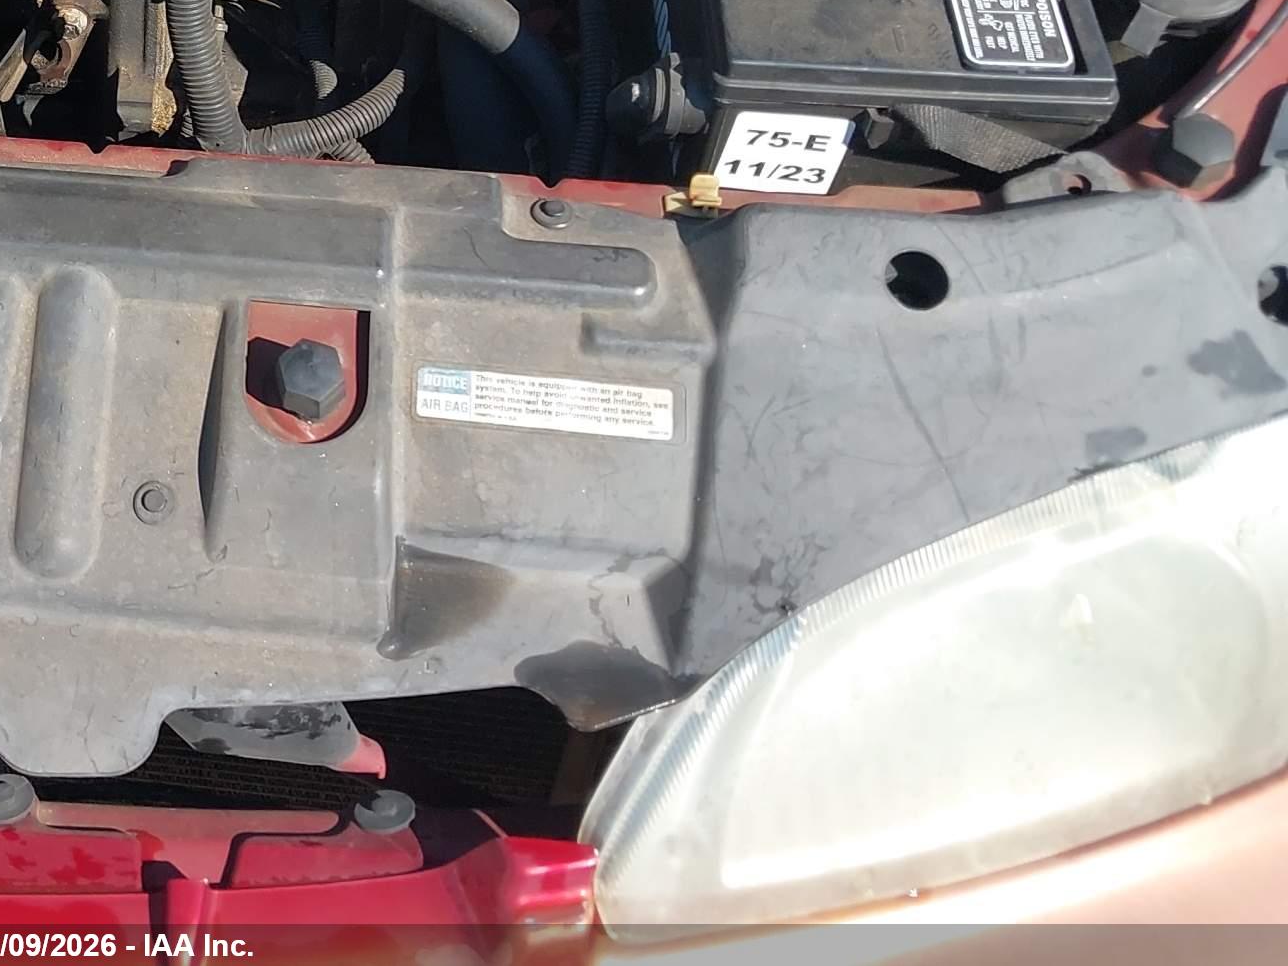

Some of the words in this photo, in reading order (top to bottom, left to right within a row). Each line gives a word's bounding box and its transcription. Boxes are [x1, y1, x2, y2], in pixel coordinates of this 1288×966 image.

[746, 129, 832, 152] 75-E
[724, 159, 827, 184] 11/23
[422, 373, 468, 390] NOTICE
[476, 374, 493, 383] This
[496, 377, 526, 387] vehicle
[528, 379, 536, 387] is
[626, 390, 643, 399] bag
[511, 387, 520, 395] To
[522, 389, 542, 398] help
[420, 398, 441, 411] AIR
[444, 400, 469, 413] BAG
[474, 402, 523, 413] procedures
[525, 407, 553, 416] before
[604, 416, 620, 425] any
[475, 394, 505, 402] service
[507, 397, 539, 406] manual
[541, 399, 553, 407] for
[602, 406, 619, 414] and
[620, 408, 652, 417] service
